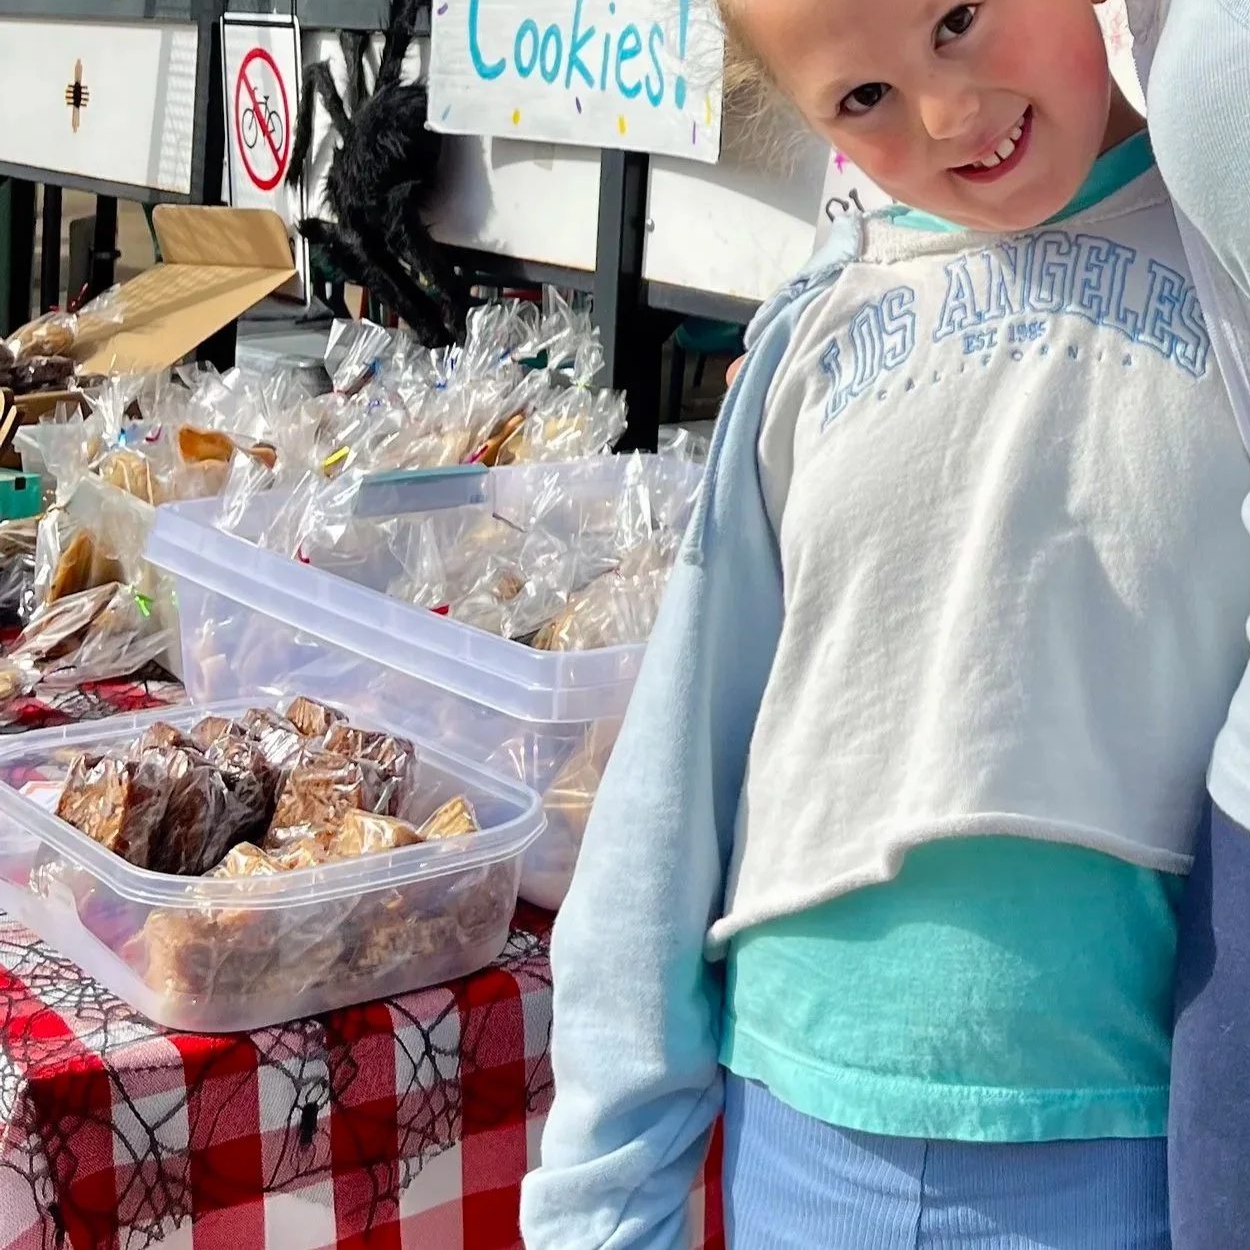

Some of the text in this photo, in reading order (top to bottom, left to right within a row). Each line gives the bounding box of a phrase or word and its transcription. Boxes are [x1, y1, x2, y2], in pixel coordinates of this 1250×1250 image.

[820, 229, 1212, 434] LOS ANGELES
[877, 343, 1133, 401] CALIFORNIA
